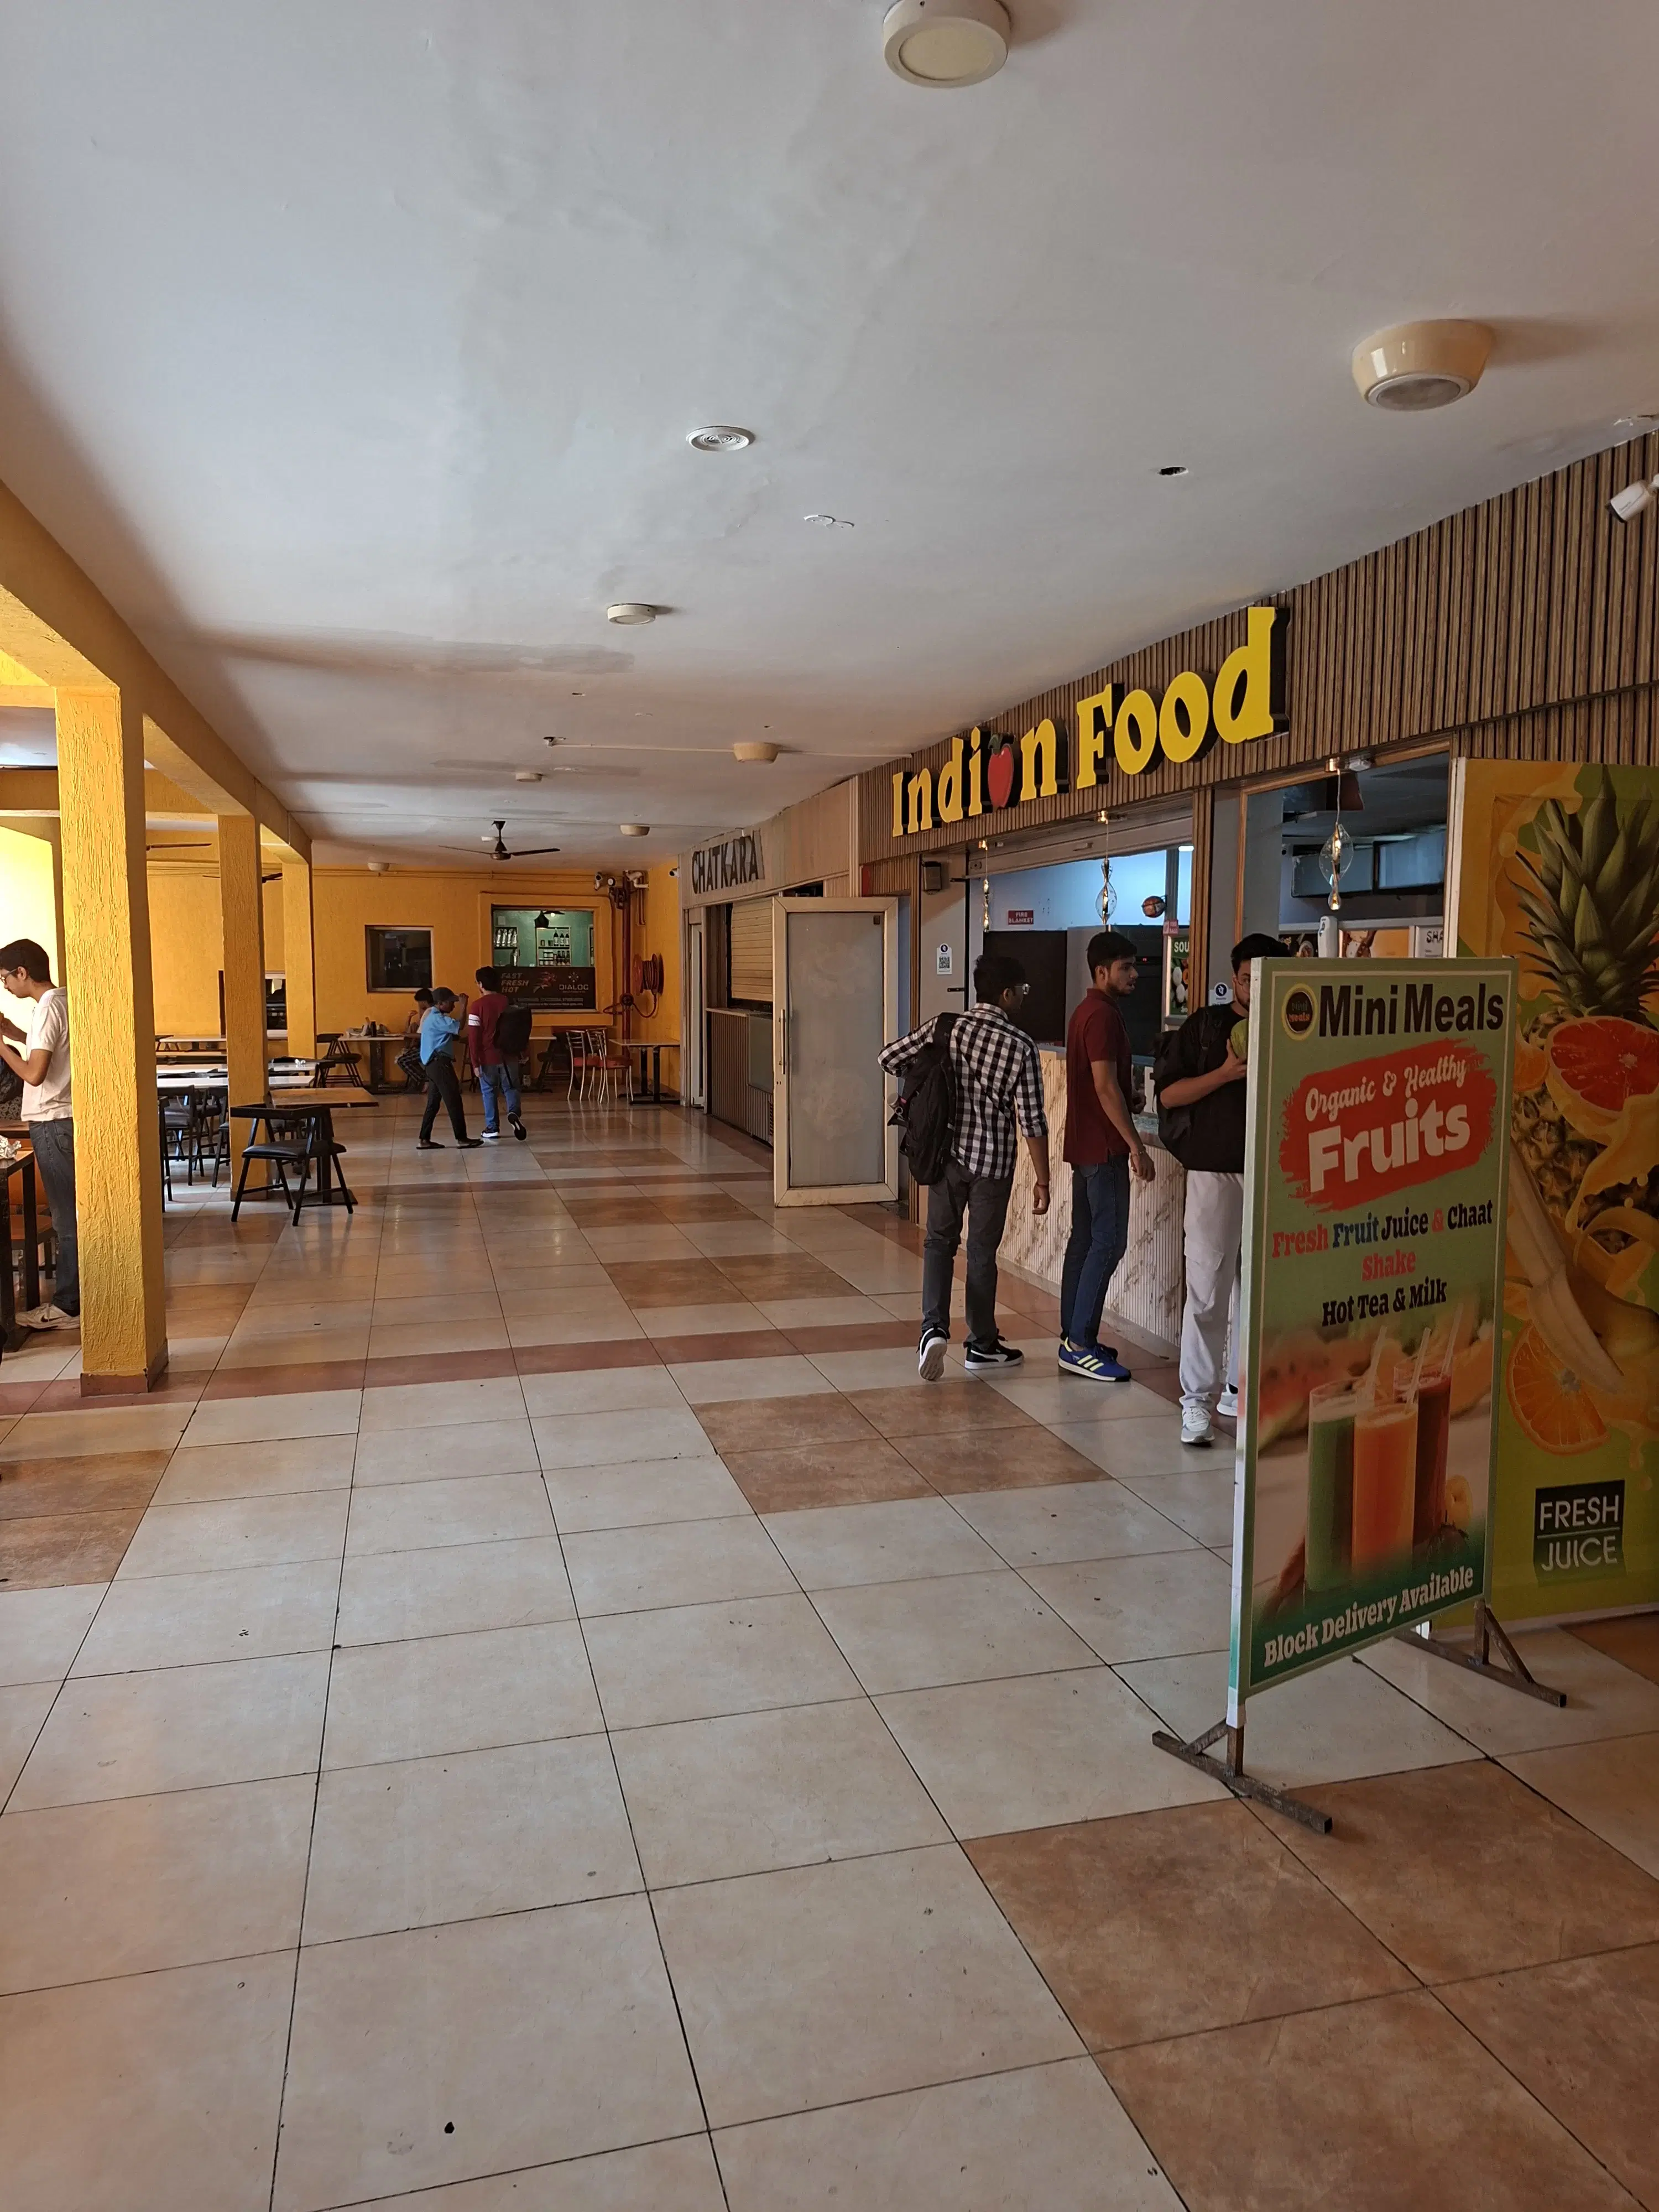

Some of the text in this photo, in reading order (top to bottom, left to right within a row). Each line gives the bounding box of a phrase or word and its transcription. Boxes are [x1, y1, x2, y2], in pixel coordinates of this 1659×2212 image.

[893, 607, 1275, 837] Indin Food
[692, 830, 760, 894] CHATKARA
[1319, 982, 1504, 1037] Mini Meals
[1306, 1055, 1467, 1121] Organic & Healthy
[1308, 1098, 1470, 1193] Fruits
[1272, 1199, 1493, 1259] Fresh Fruit Juice & Chaat
[1322, 1276, 1447, 1327] Hot Tea & Milk
[1540, 1494, 1619, 1531] FRESH
[1541, 1535, 1618, 1571] JUICE
[1264, 1565, 1473, 1668] Block Delivery Available
